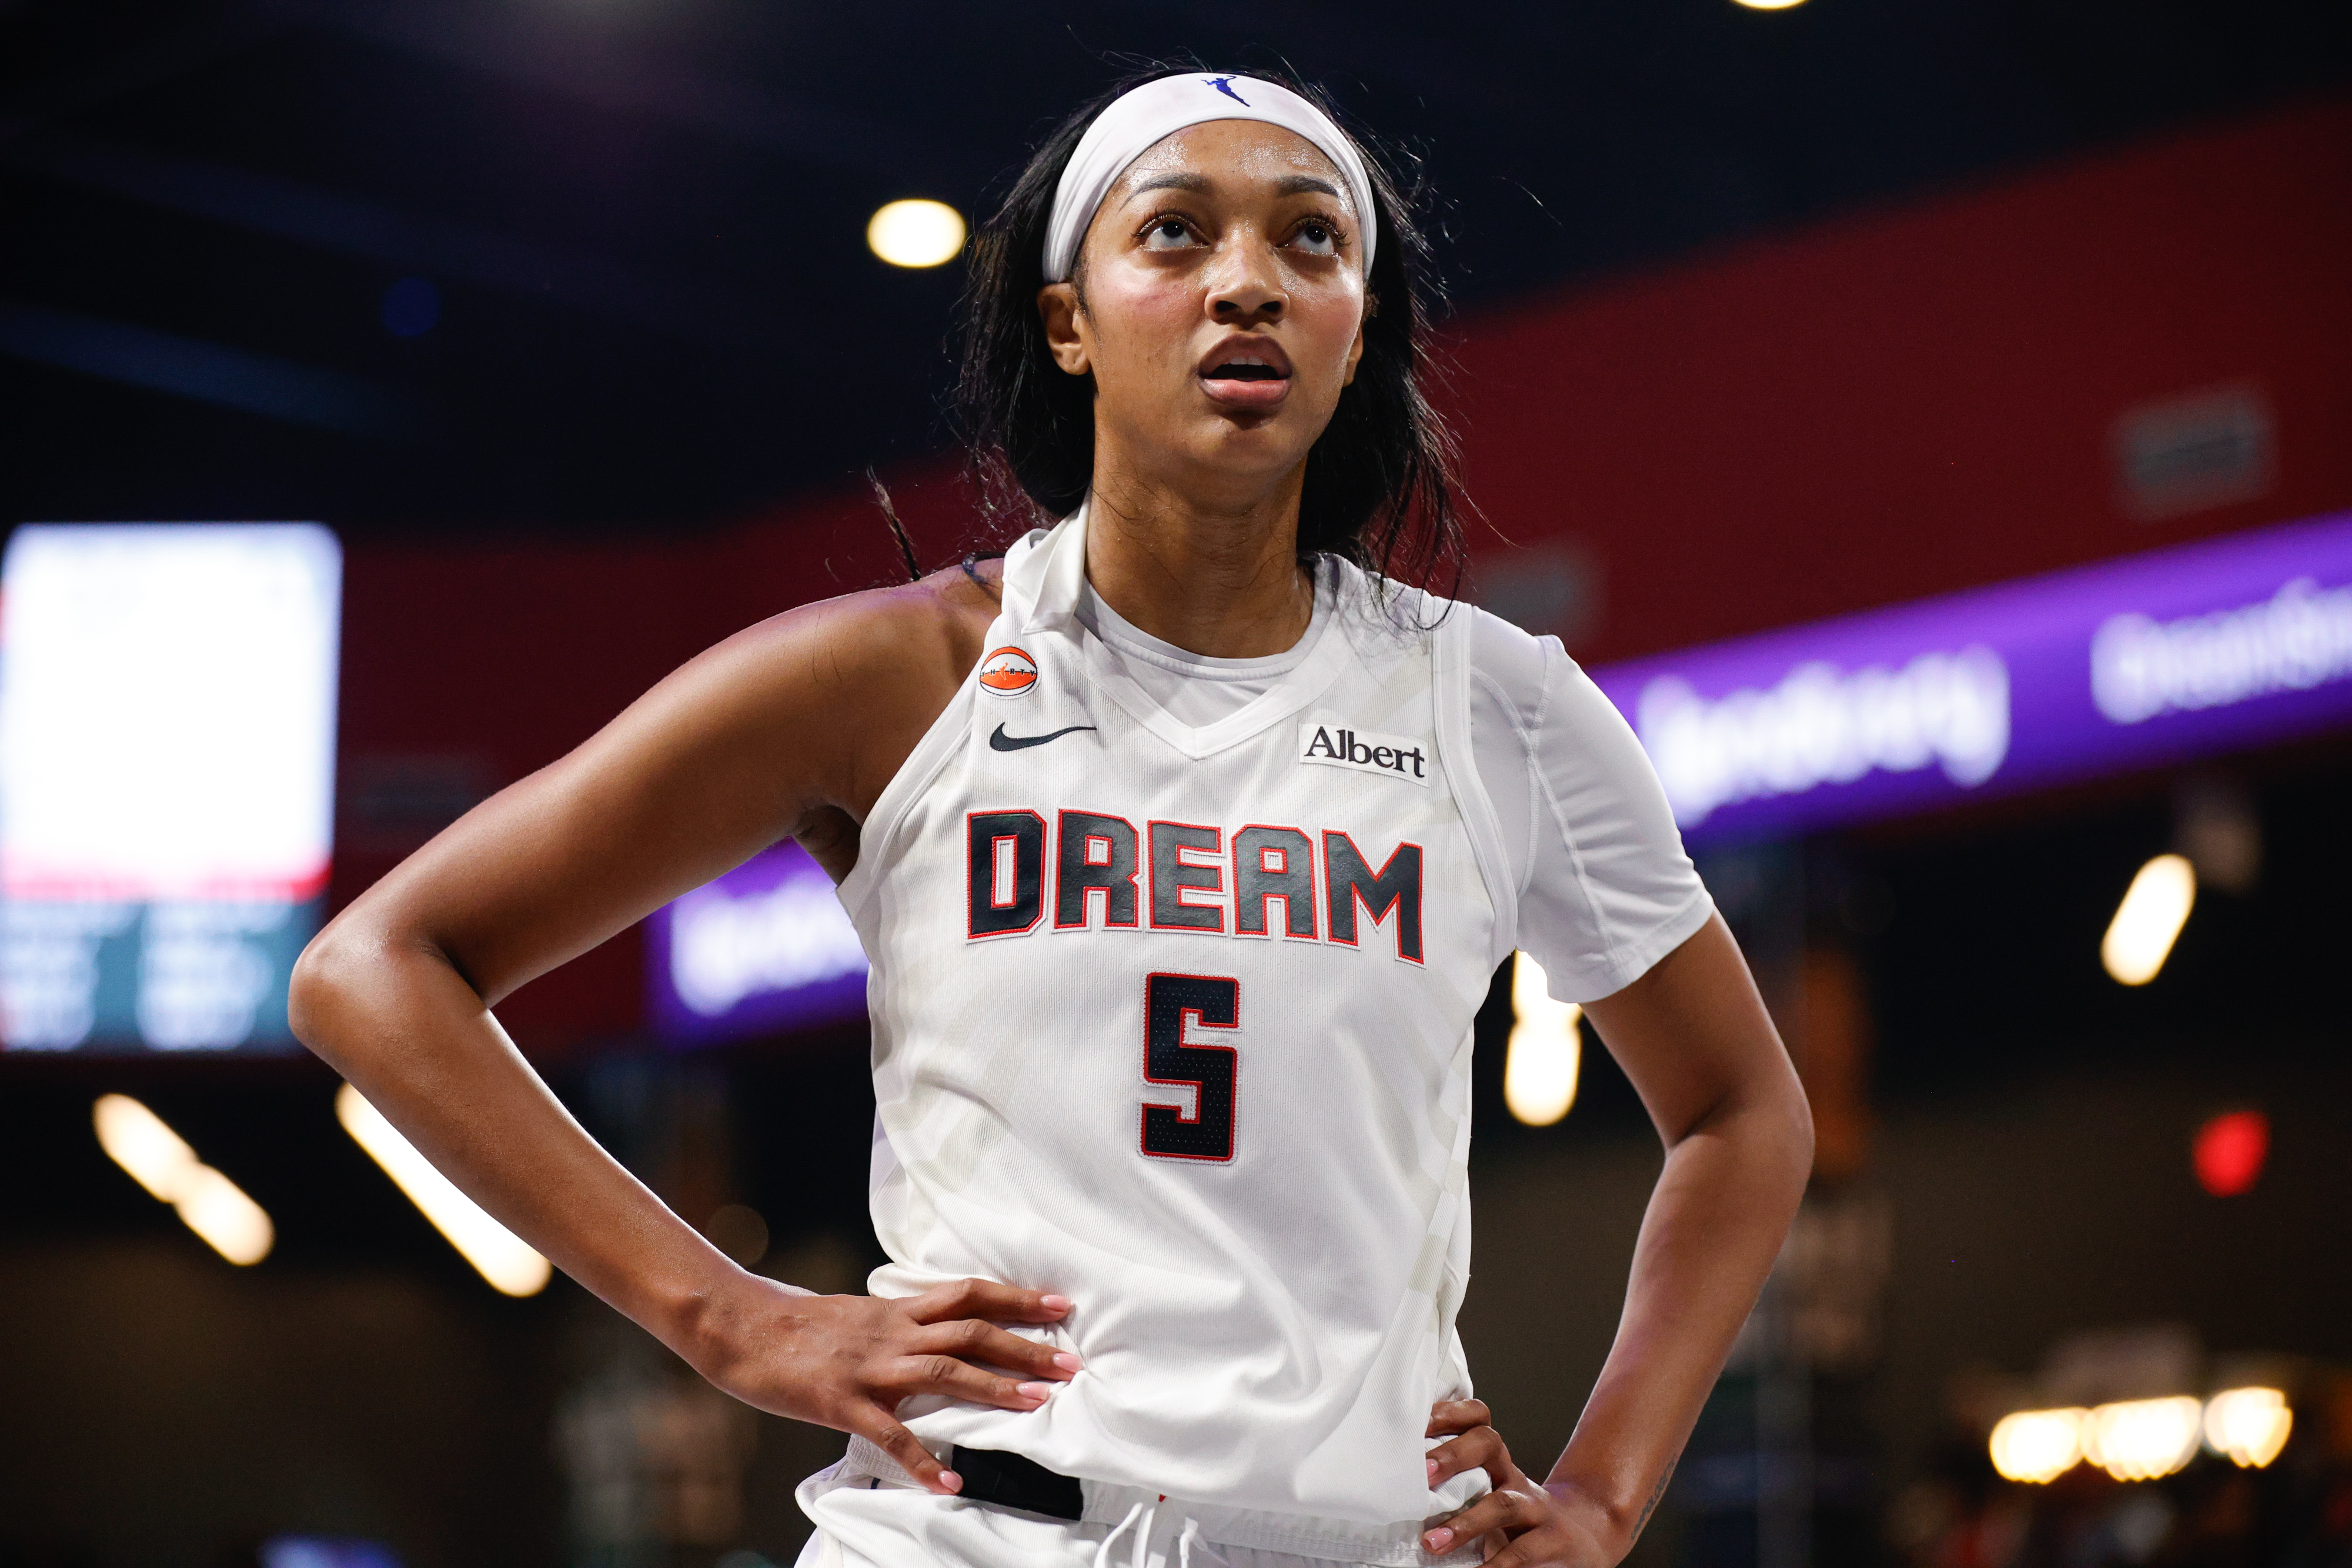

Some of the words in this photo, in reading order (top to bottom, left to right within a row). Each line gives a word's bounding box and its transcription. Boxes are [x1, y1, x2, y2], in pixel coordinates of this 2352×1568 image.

[1304, 726, 1425, 777] Albert
[966, 808, 1424, 965] DREAM
[1140, 972, 1240, 1160] 5
